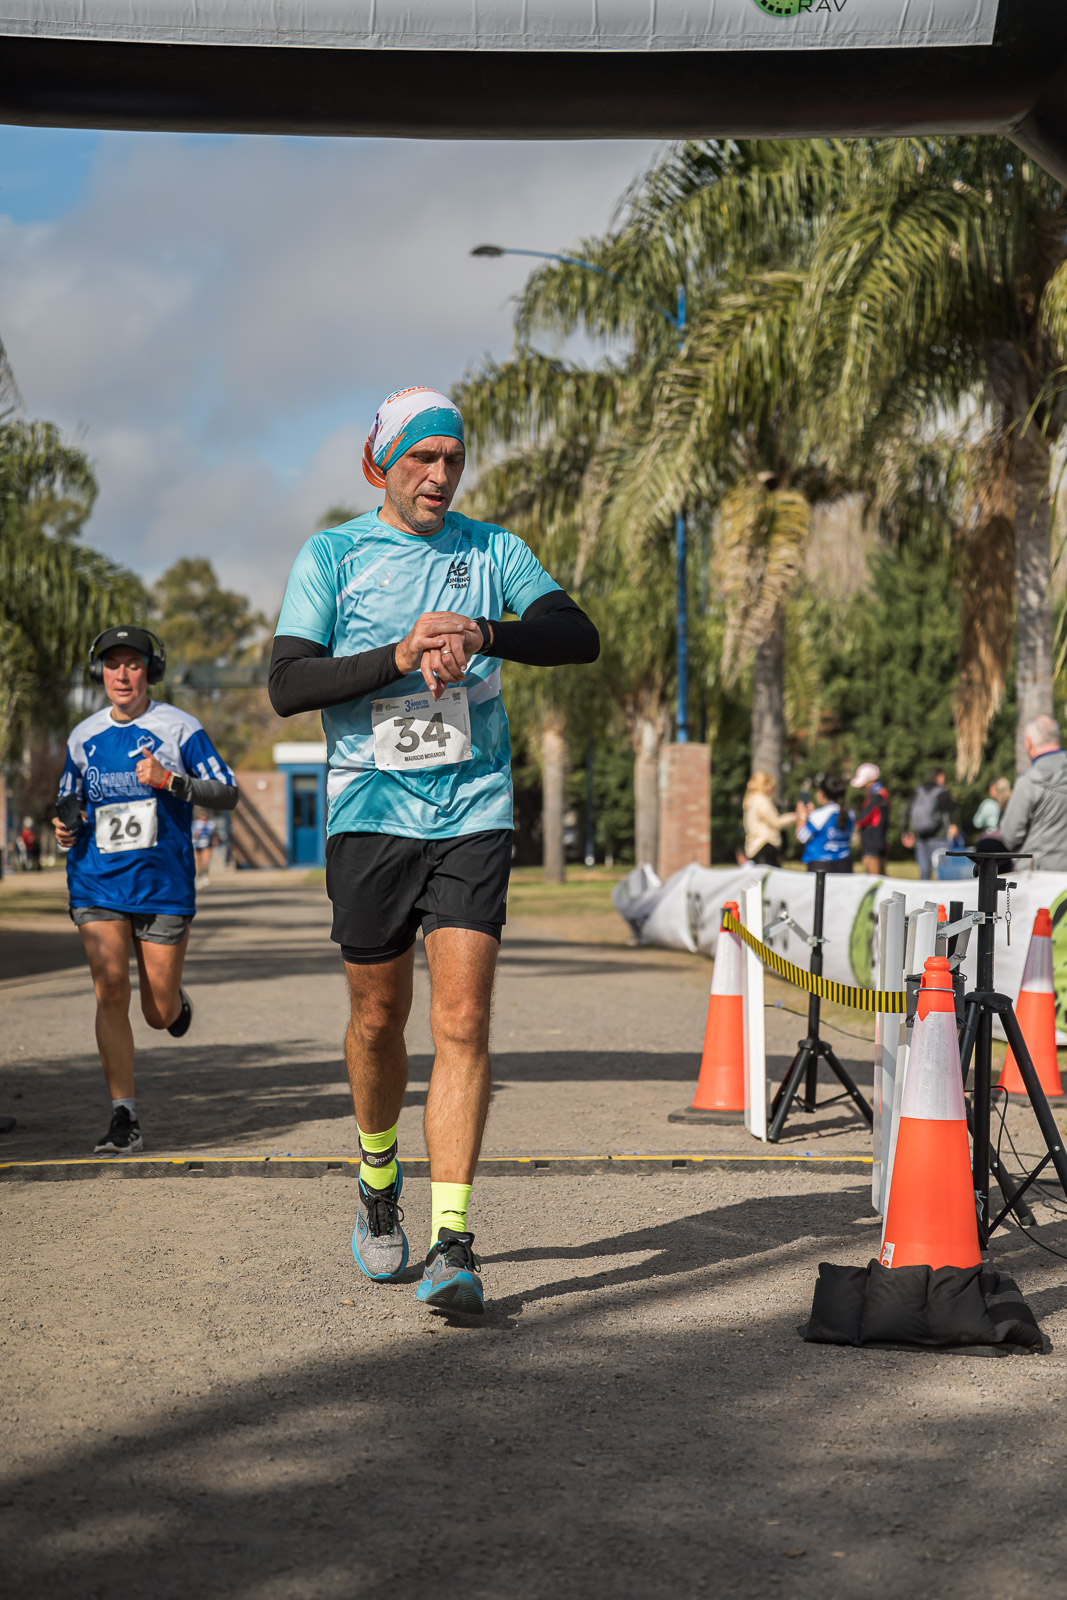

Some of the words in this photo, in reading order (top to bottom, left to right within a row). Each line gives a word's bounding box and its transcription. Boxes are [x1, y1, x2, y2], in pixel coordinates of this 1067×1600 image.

[393, 711, 451, 753] 34
[404, 754, 424, 762] MAURICIO
[87, 766, 103, 802] 3
[100, 771, 139, 788] MARAT
[109, 815, 142, 841] 26
